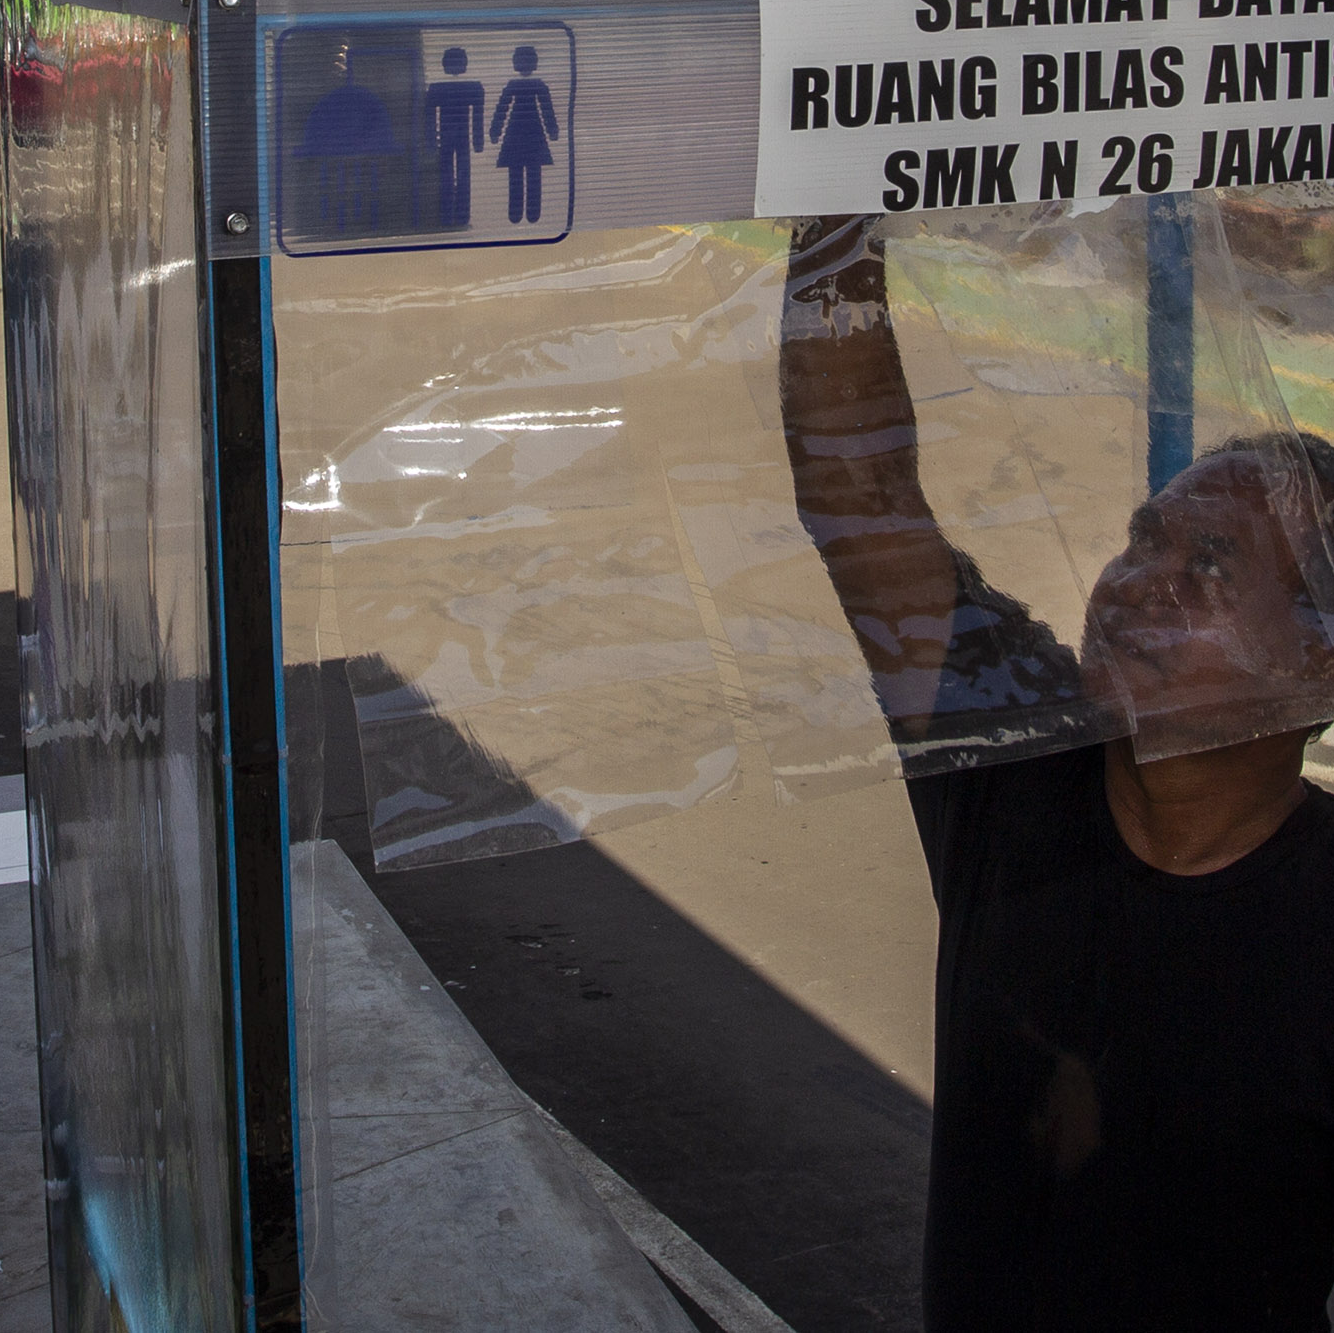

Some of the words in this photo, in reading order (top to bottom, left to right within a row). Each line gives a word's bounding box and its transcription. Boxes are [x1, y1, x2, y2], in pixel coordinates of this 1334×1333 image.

[791, 55, 998, 131] RUANG
[1022, 46, 1185, 116] BILAS
[882, 143, 1020, 212] SMK
[1039, 140, 1079, 201] N
[1098, 133, 1175, 197] 26
